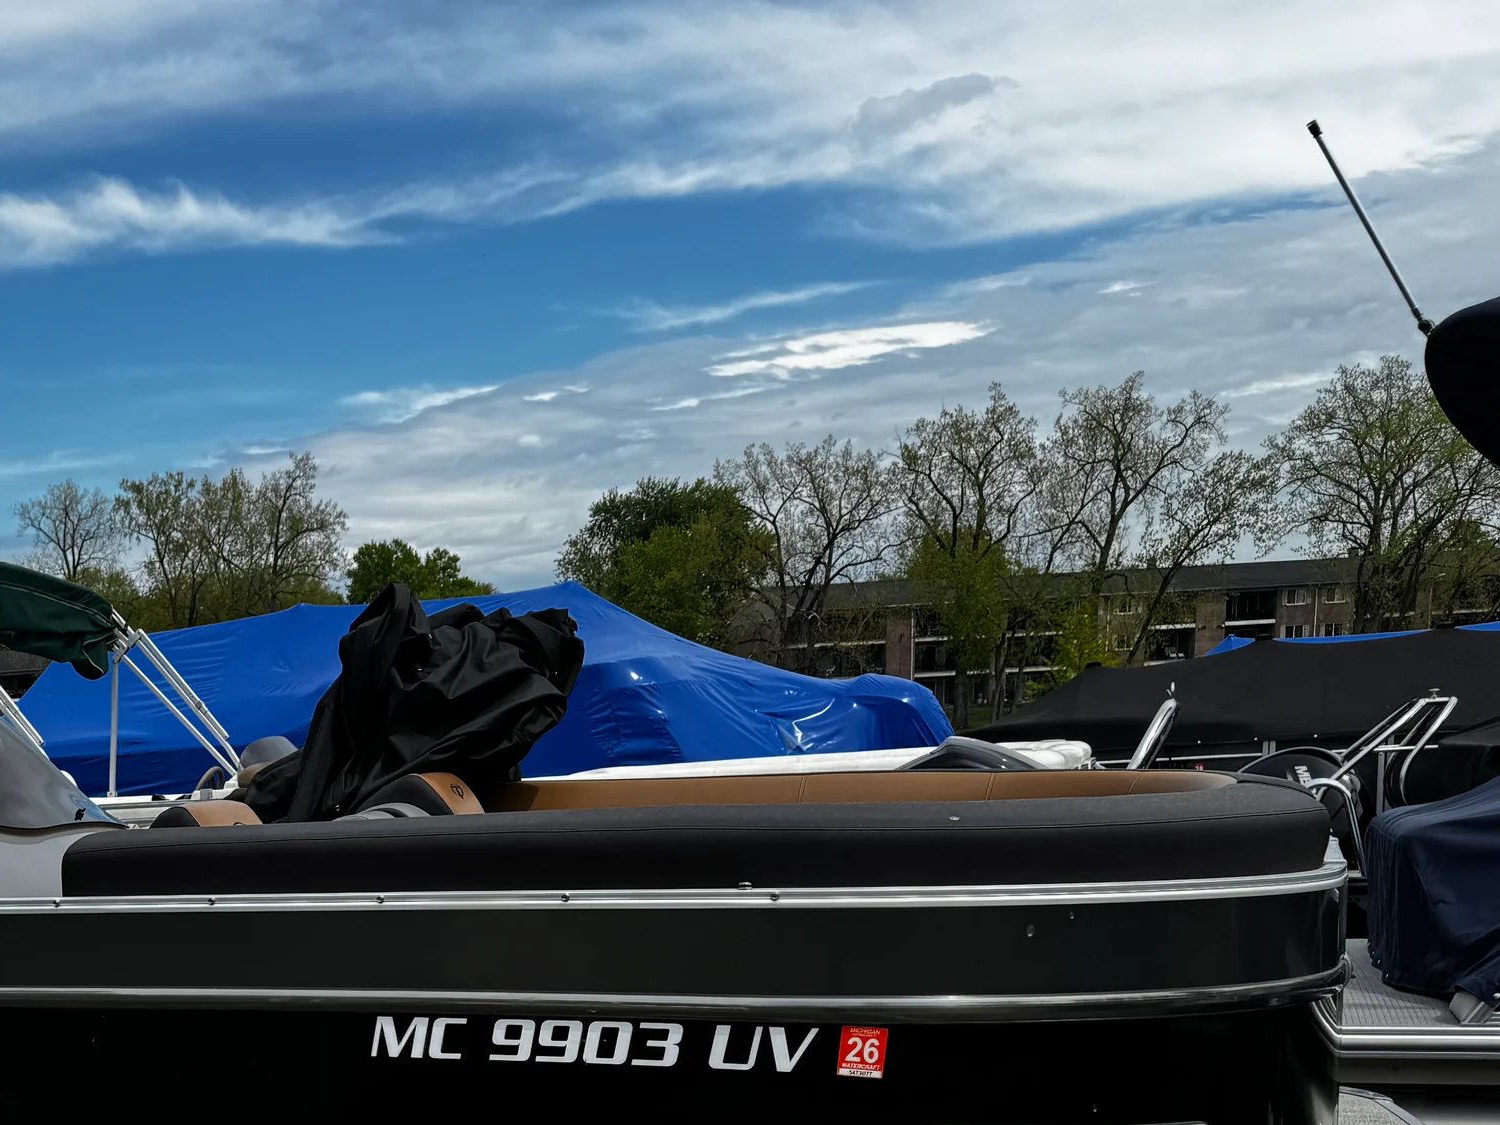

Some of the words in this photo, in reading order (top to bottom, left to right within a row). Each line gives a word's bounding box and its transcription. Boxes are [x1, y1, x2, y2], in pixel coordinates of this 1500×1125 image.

[371, 1016, 468, 1060] MC
[489, 1019, 684, 1067] 9903
[708, 1025, 820, 1073] UV
[845, 1037, 880, 1064] 26
